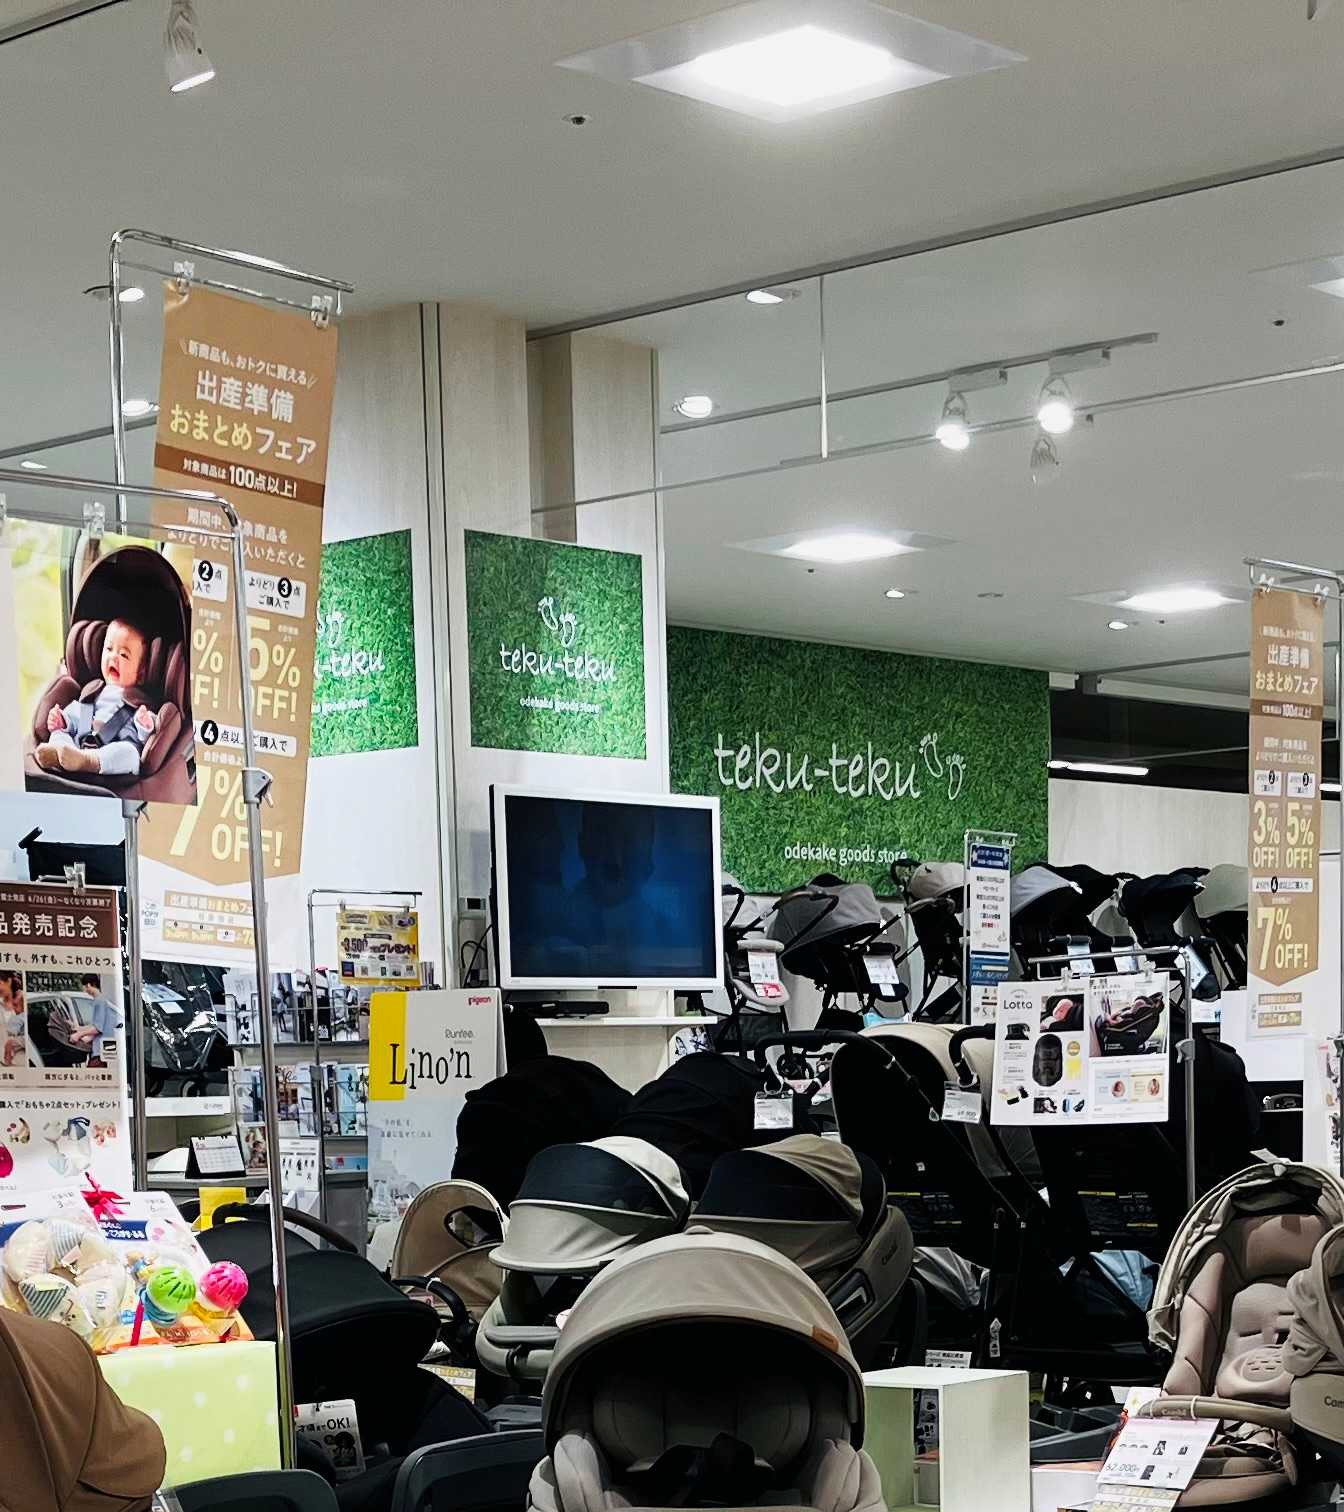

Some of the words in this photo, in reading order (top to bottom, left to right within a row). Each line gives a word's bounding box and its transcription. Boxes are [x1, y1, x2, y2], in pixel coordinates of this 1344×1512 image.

[196, 370, 294, 423] 出産準備
[170, 404, 316, 465] おまとめフェア
[259, 595, 290, 610] ご購入で
[499, 642, 617, 683] teku-teku
[1256, 670, 1318, 695] おまとめフェア
[713, 732, 921, 802] teku-teku
[1253, 800, 1280, 845] 3%
[1286, 802, 1314, 845] 5%
[783, 840, 837, 864] odekake
[840, 843, 877, 866] goods
[880, 845, 909, 865] store
[1253, 847, 1279, 868] OFF!
[1286, 847, 1313, 869] OFF!
[1257, 906, 1292, 970] 7%
[1275, 943, 1308, 969] OFF!
[468, 996, 492, 1006] pigeon
[1004, 1000, 1033, 1010] Lotta
